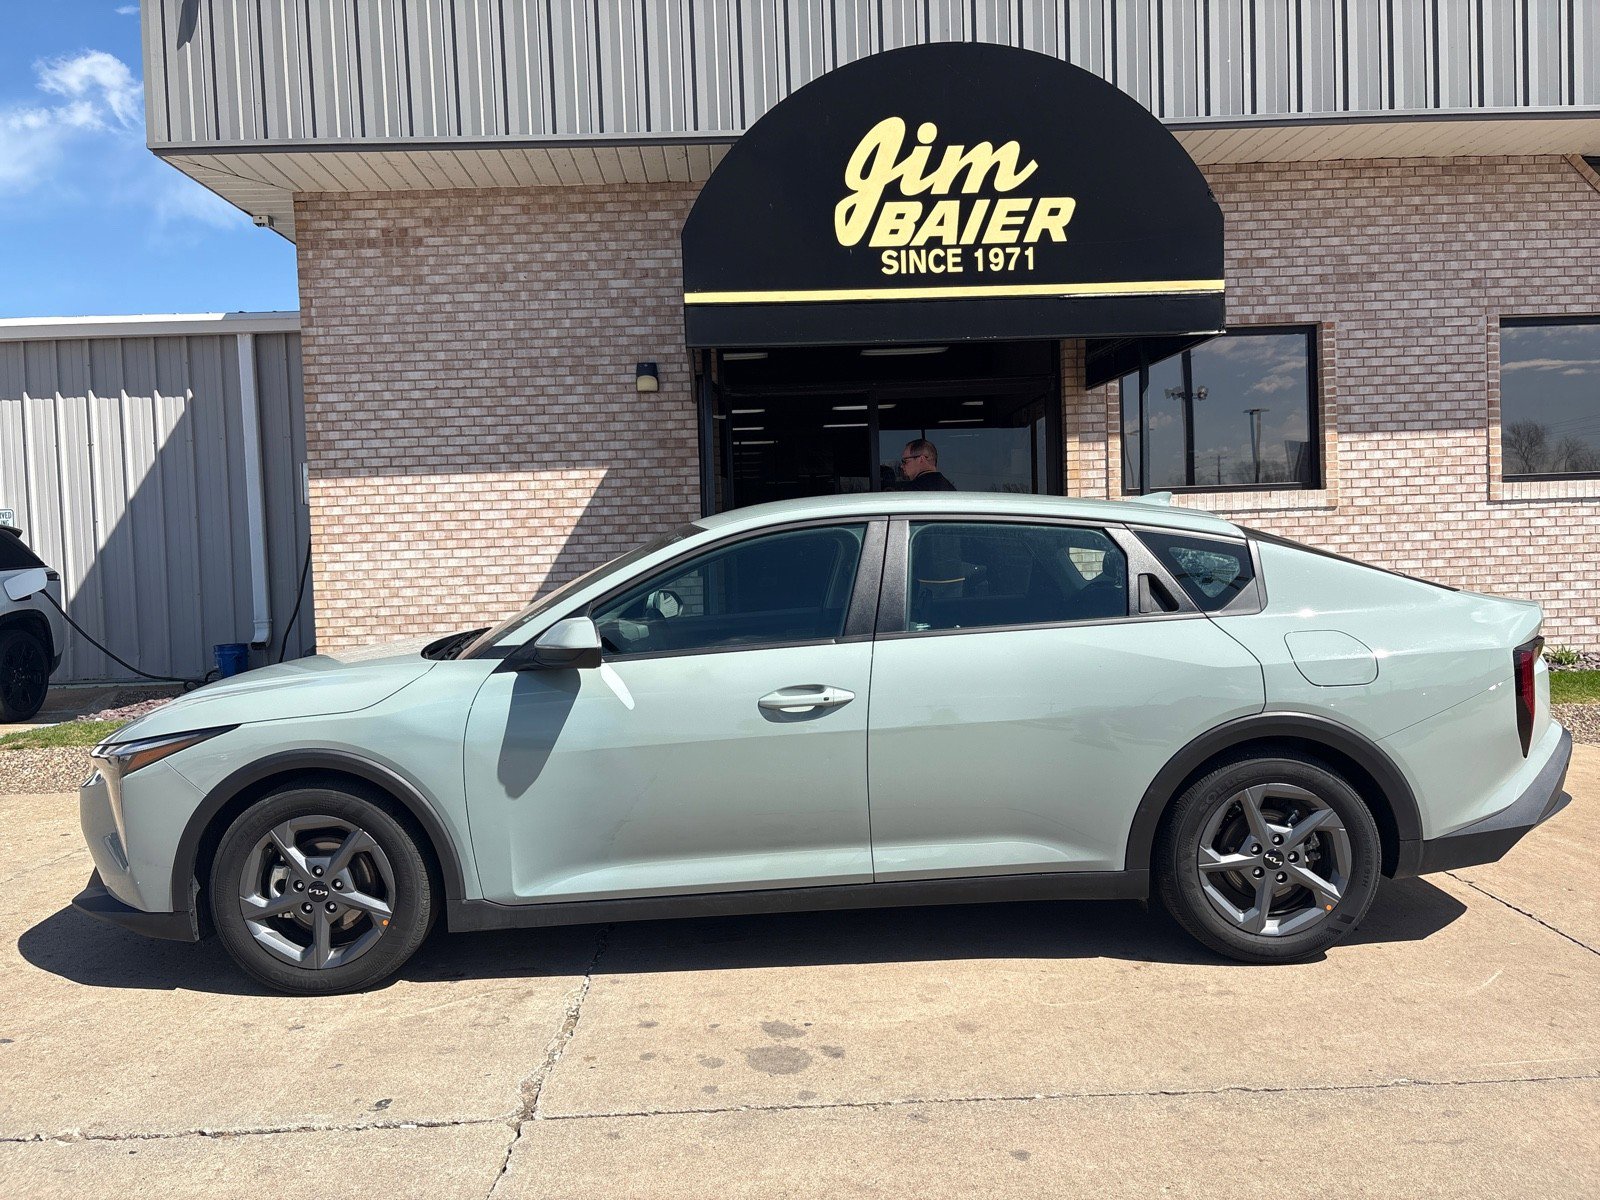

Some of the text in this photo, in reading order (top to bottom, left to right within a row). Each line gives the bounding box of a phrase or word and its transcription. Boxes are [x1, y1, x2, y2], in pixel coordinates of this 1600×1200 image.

[834, 116, 1039, 247] Jim
[868, 197, 1076, 247] BAIER
[881, 246, 1035, 275] SINCE 1971
